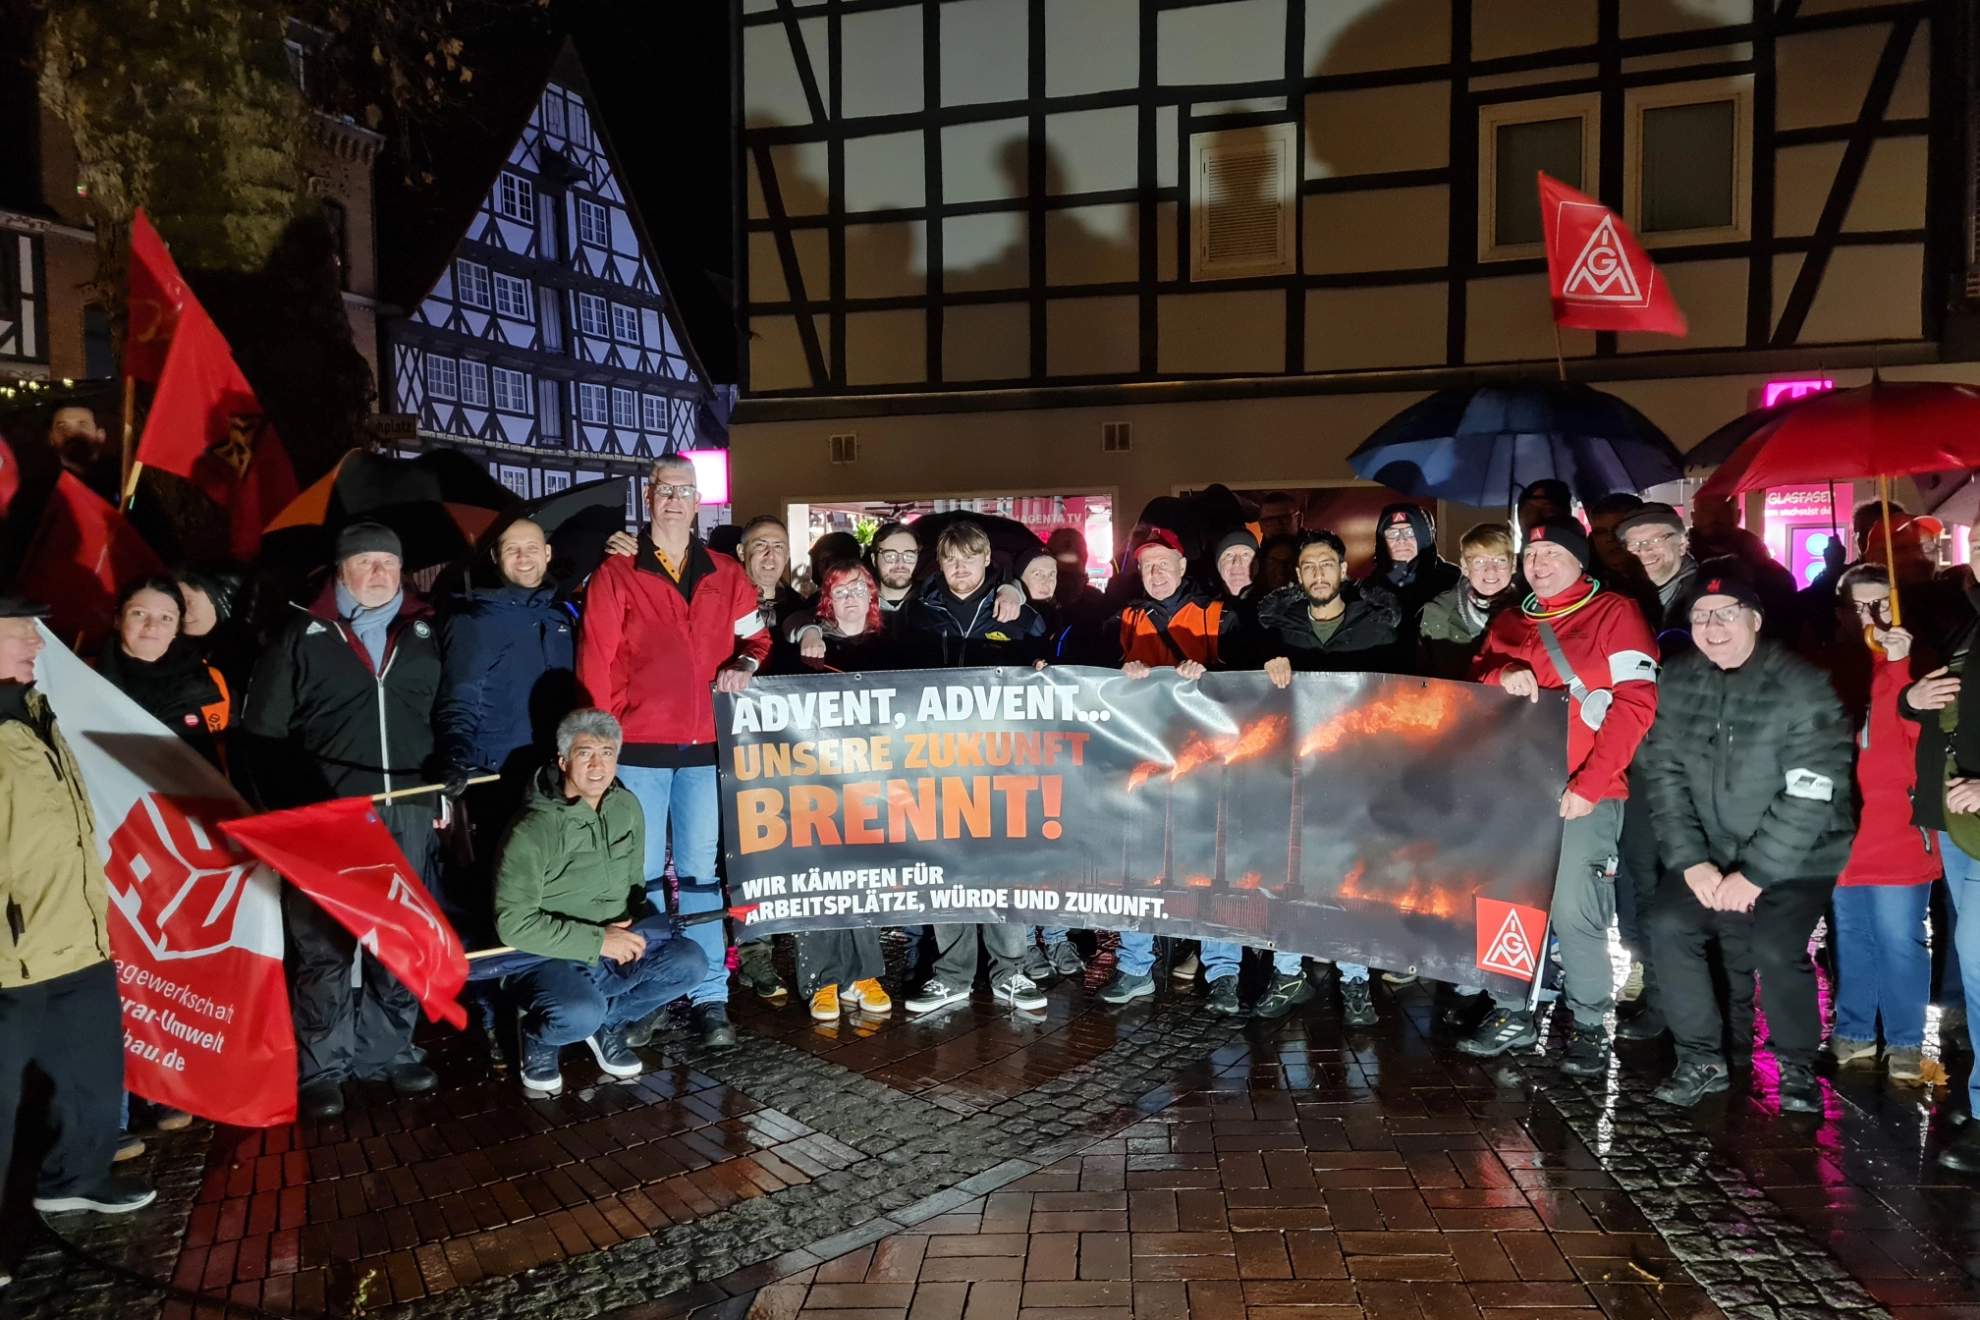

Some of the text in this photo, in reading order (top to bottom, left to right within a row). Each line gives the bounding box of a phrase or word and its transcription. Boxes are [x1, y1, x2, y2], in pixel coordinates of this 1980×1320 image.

[377, 418, 411, 436] hplatz
[1067, 512, 1082, 523] TV
[731, 685, 1111, 735] ADVENT, ADVENT...
[733, 731, 1090, 781] UNSERE ZUKUNFT
[736, 775, 1063, 855] BRENNT!
[742, 862, 944, 900] WIR KÄMPFEN FÜR
[745, 884, 1169, 926] ARBEITSPLÄTZE, WÜRDE UND ZUKUNFT.
[111, 955, 235, 1025] egewerkschaft
[120, 996, 225, 1054] rar-Umwelt
